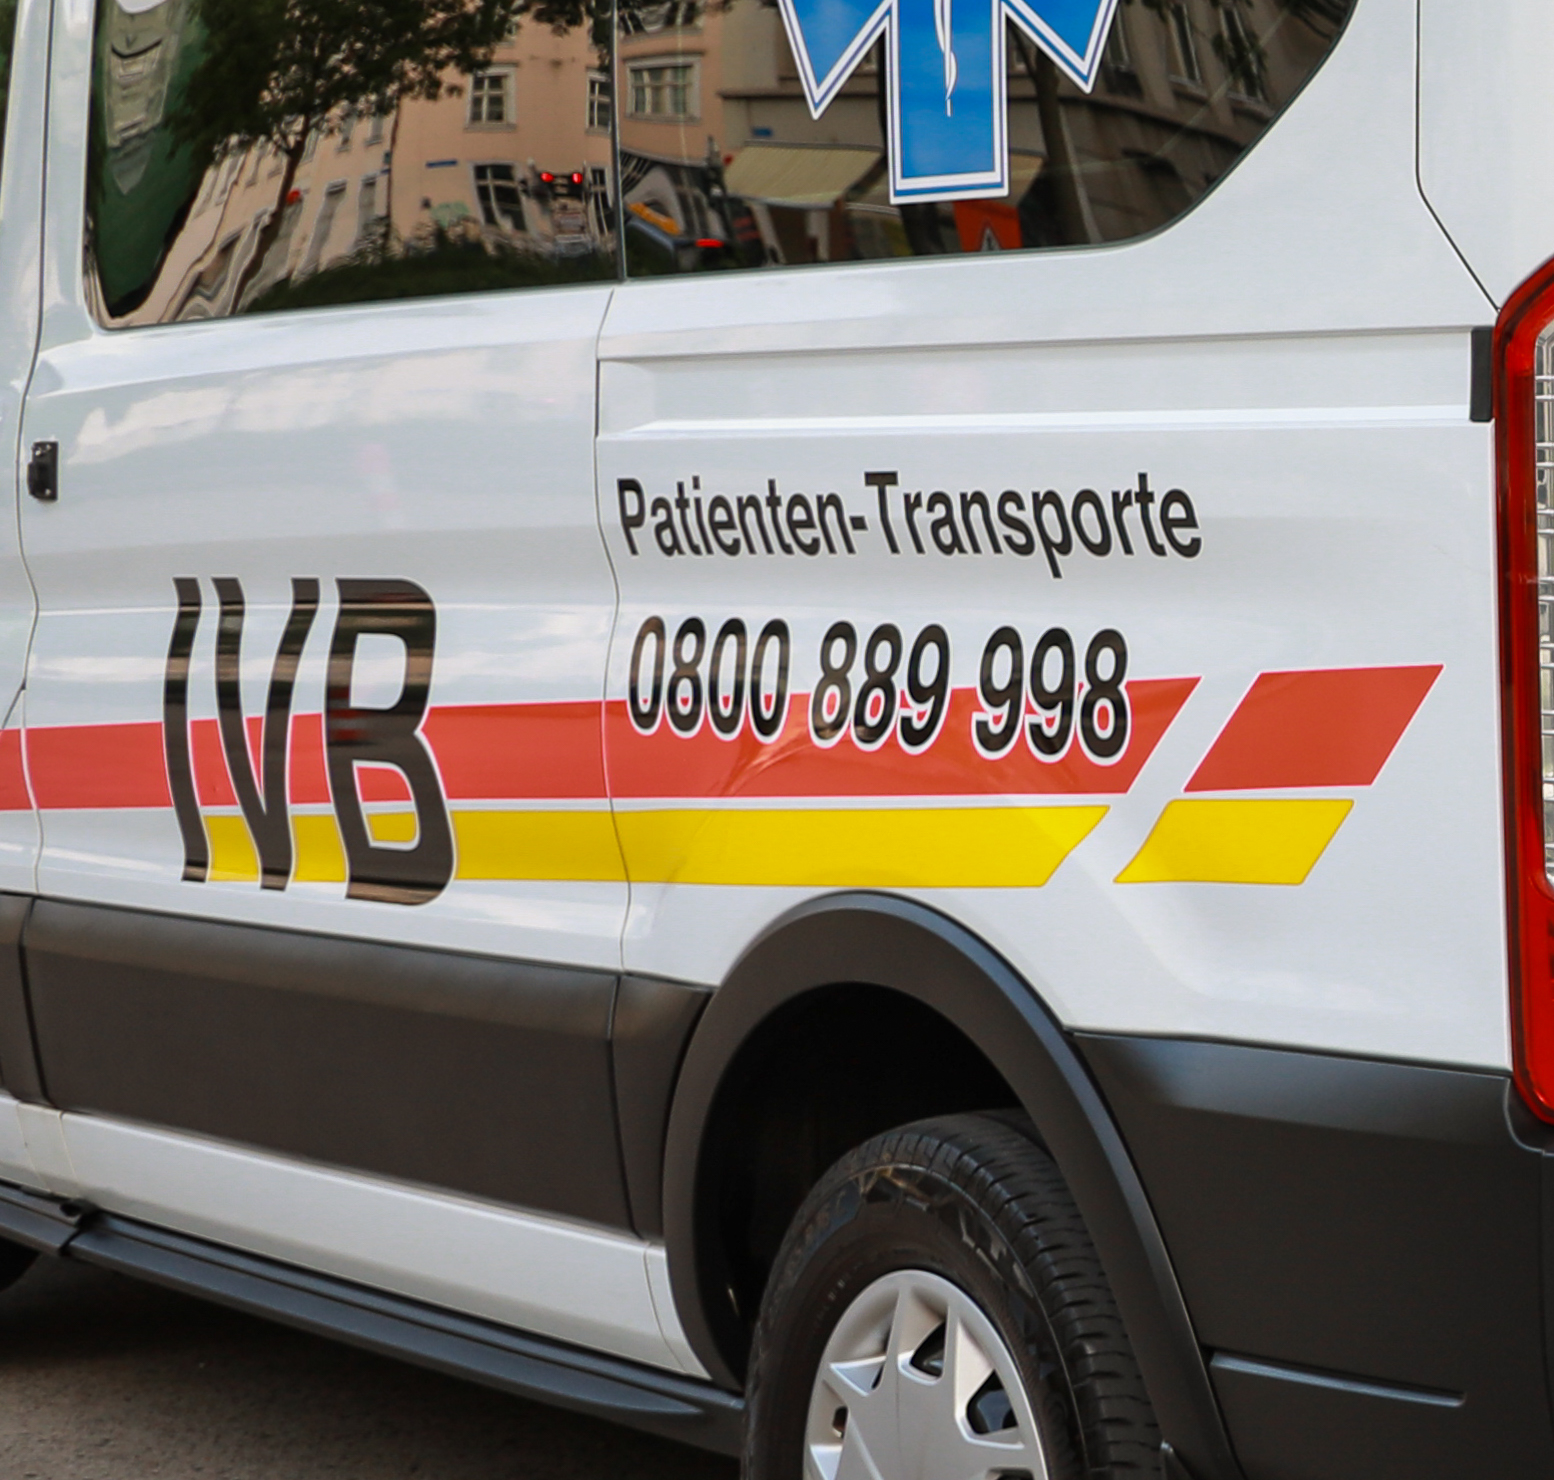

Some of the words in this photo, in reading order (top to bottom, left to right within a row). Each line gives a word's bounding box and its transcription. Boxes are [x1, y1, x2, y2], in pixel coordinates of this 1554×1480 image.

[616, 470, 1202, 579] Patienten-Transporte
[162, 576, 456, 906] IVB
[627, 616, 791, 737] 0800
[812, 620, 950, 750] 889
[974, 625, 1128, 759] 998
